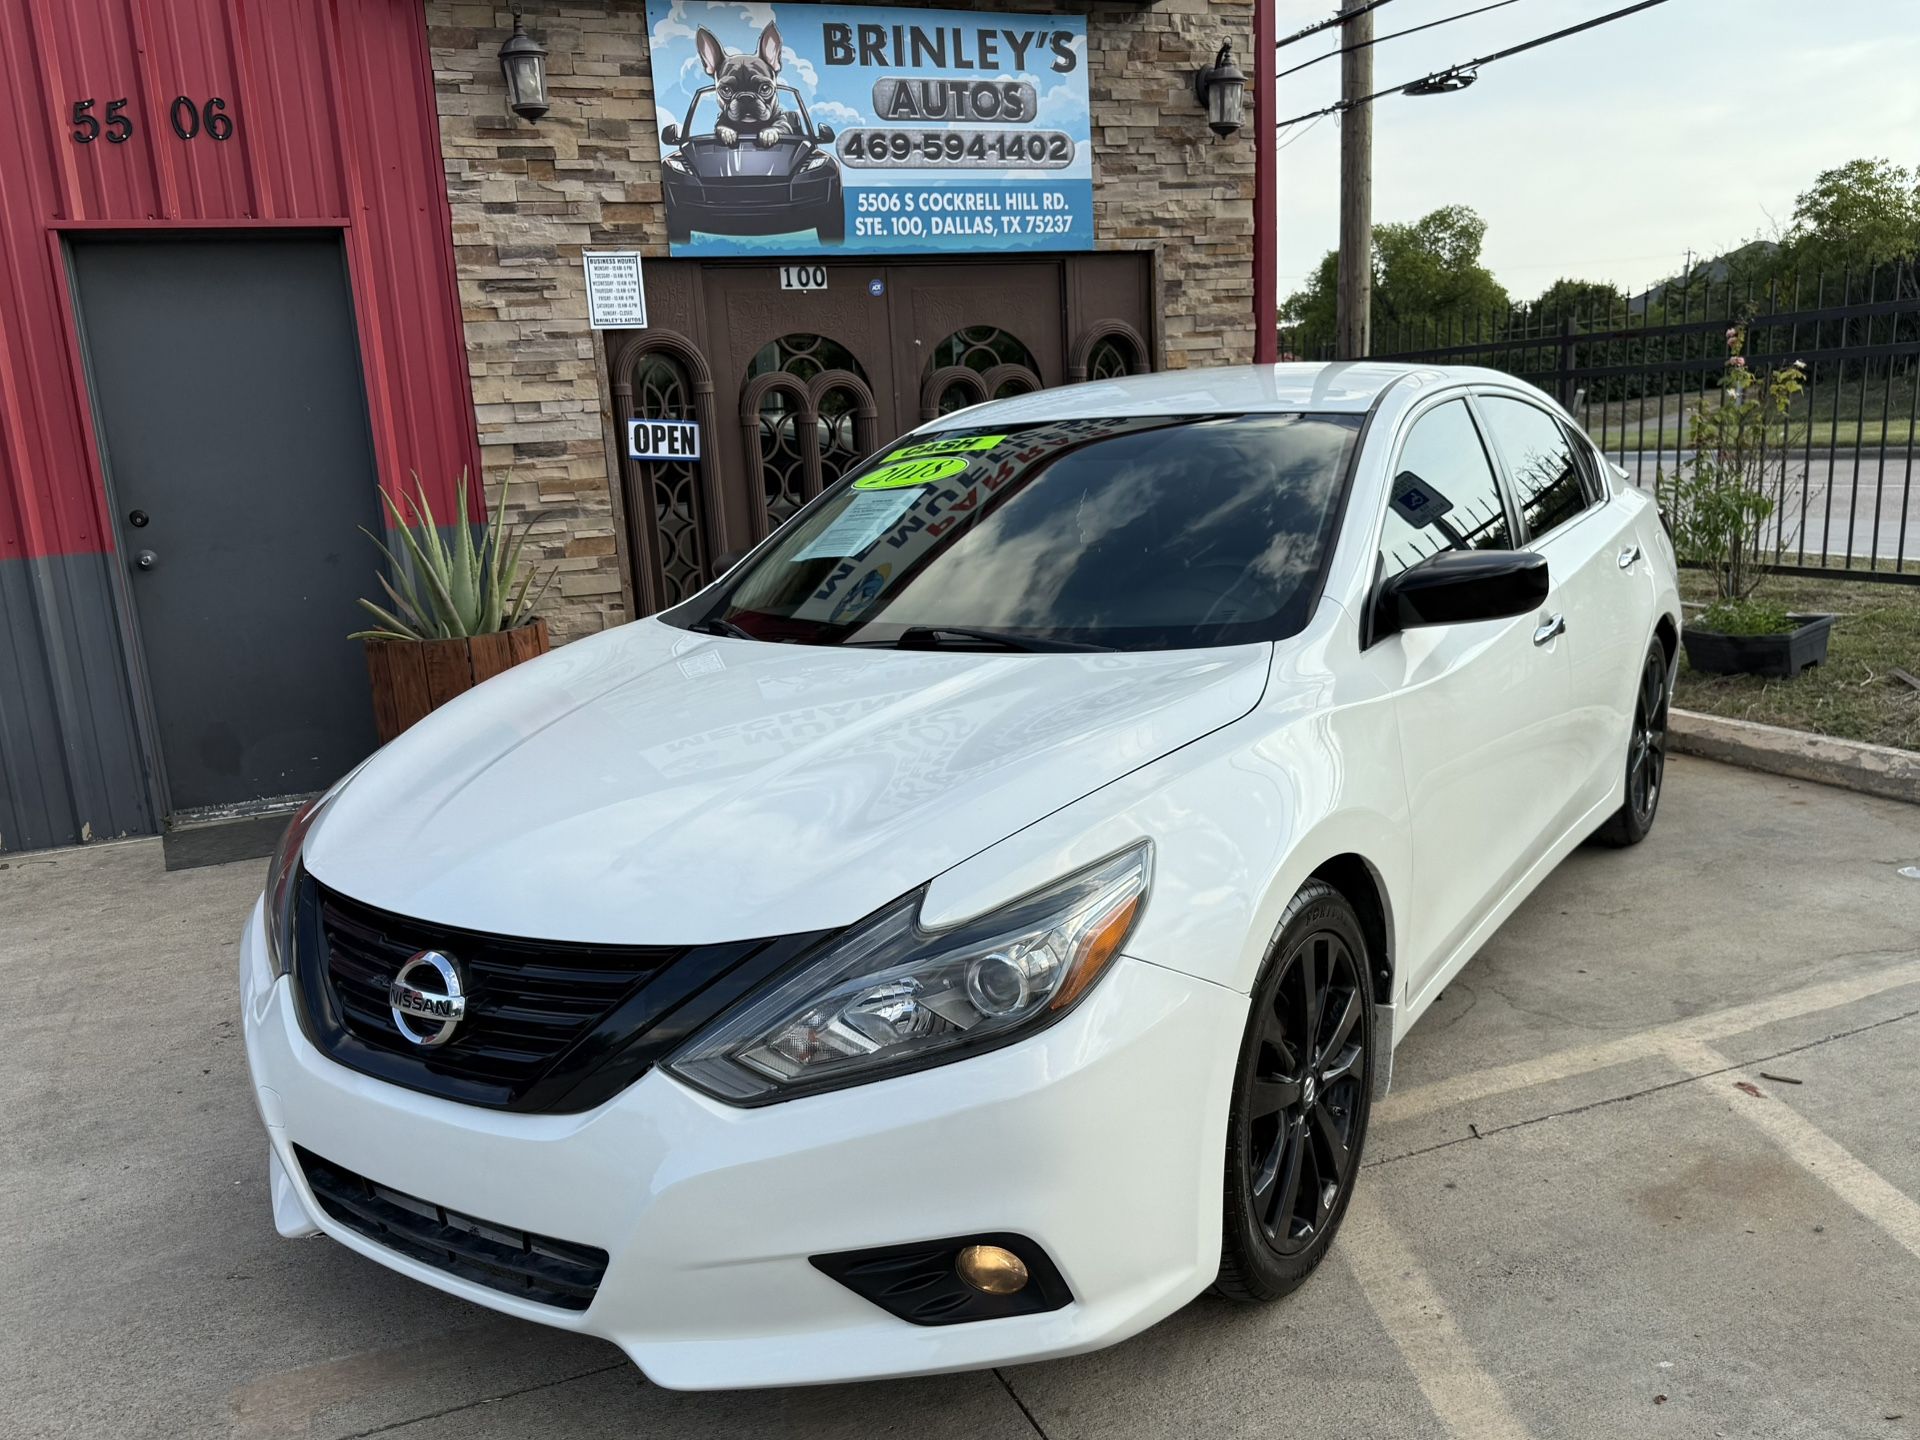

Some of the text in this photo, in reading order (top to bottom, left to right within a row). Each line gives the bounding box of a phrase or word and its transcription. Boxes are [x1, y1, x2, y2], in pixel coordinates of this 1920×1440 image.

[823, 22, 1077, 74] BRINLEY'S
[888, 79, 1025, 120] AUTOS
[845, 132, 1069, 163] 469-594-1402
[858, 192, 1069, 212] 5506 S COCKRELL HILL RD.
[856, 215, 1073, 238] STE. 100, DALLAS, TX 75237
[784, 266, 826, 288] 100
[634, 424, 696, 455] OPEN
[902, 438, 984, 457] CASH
[864, 460, 955, 486] 2018
[390, 988, 451, 1015] NISSAN
